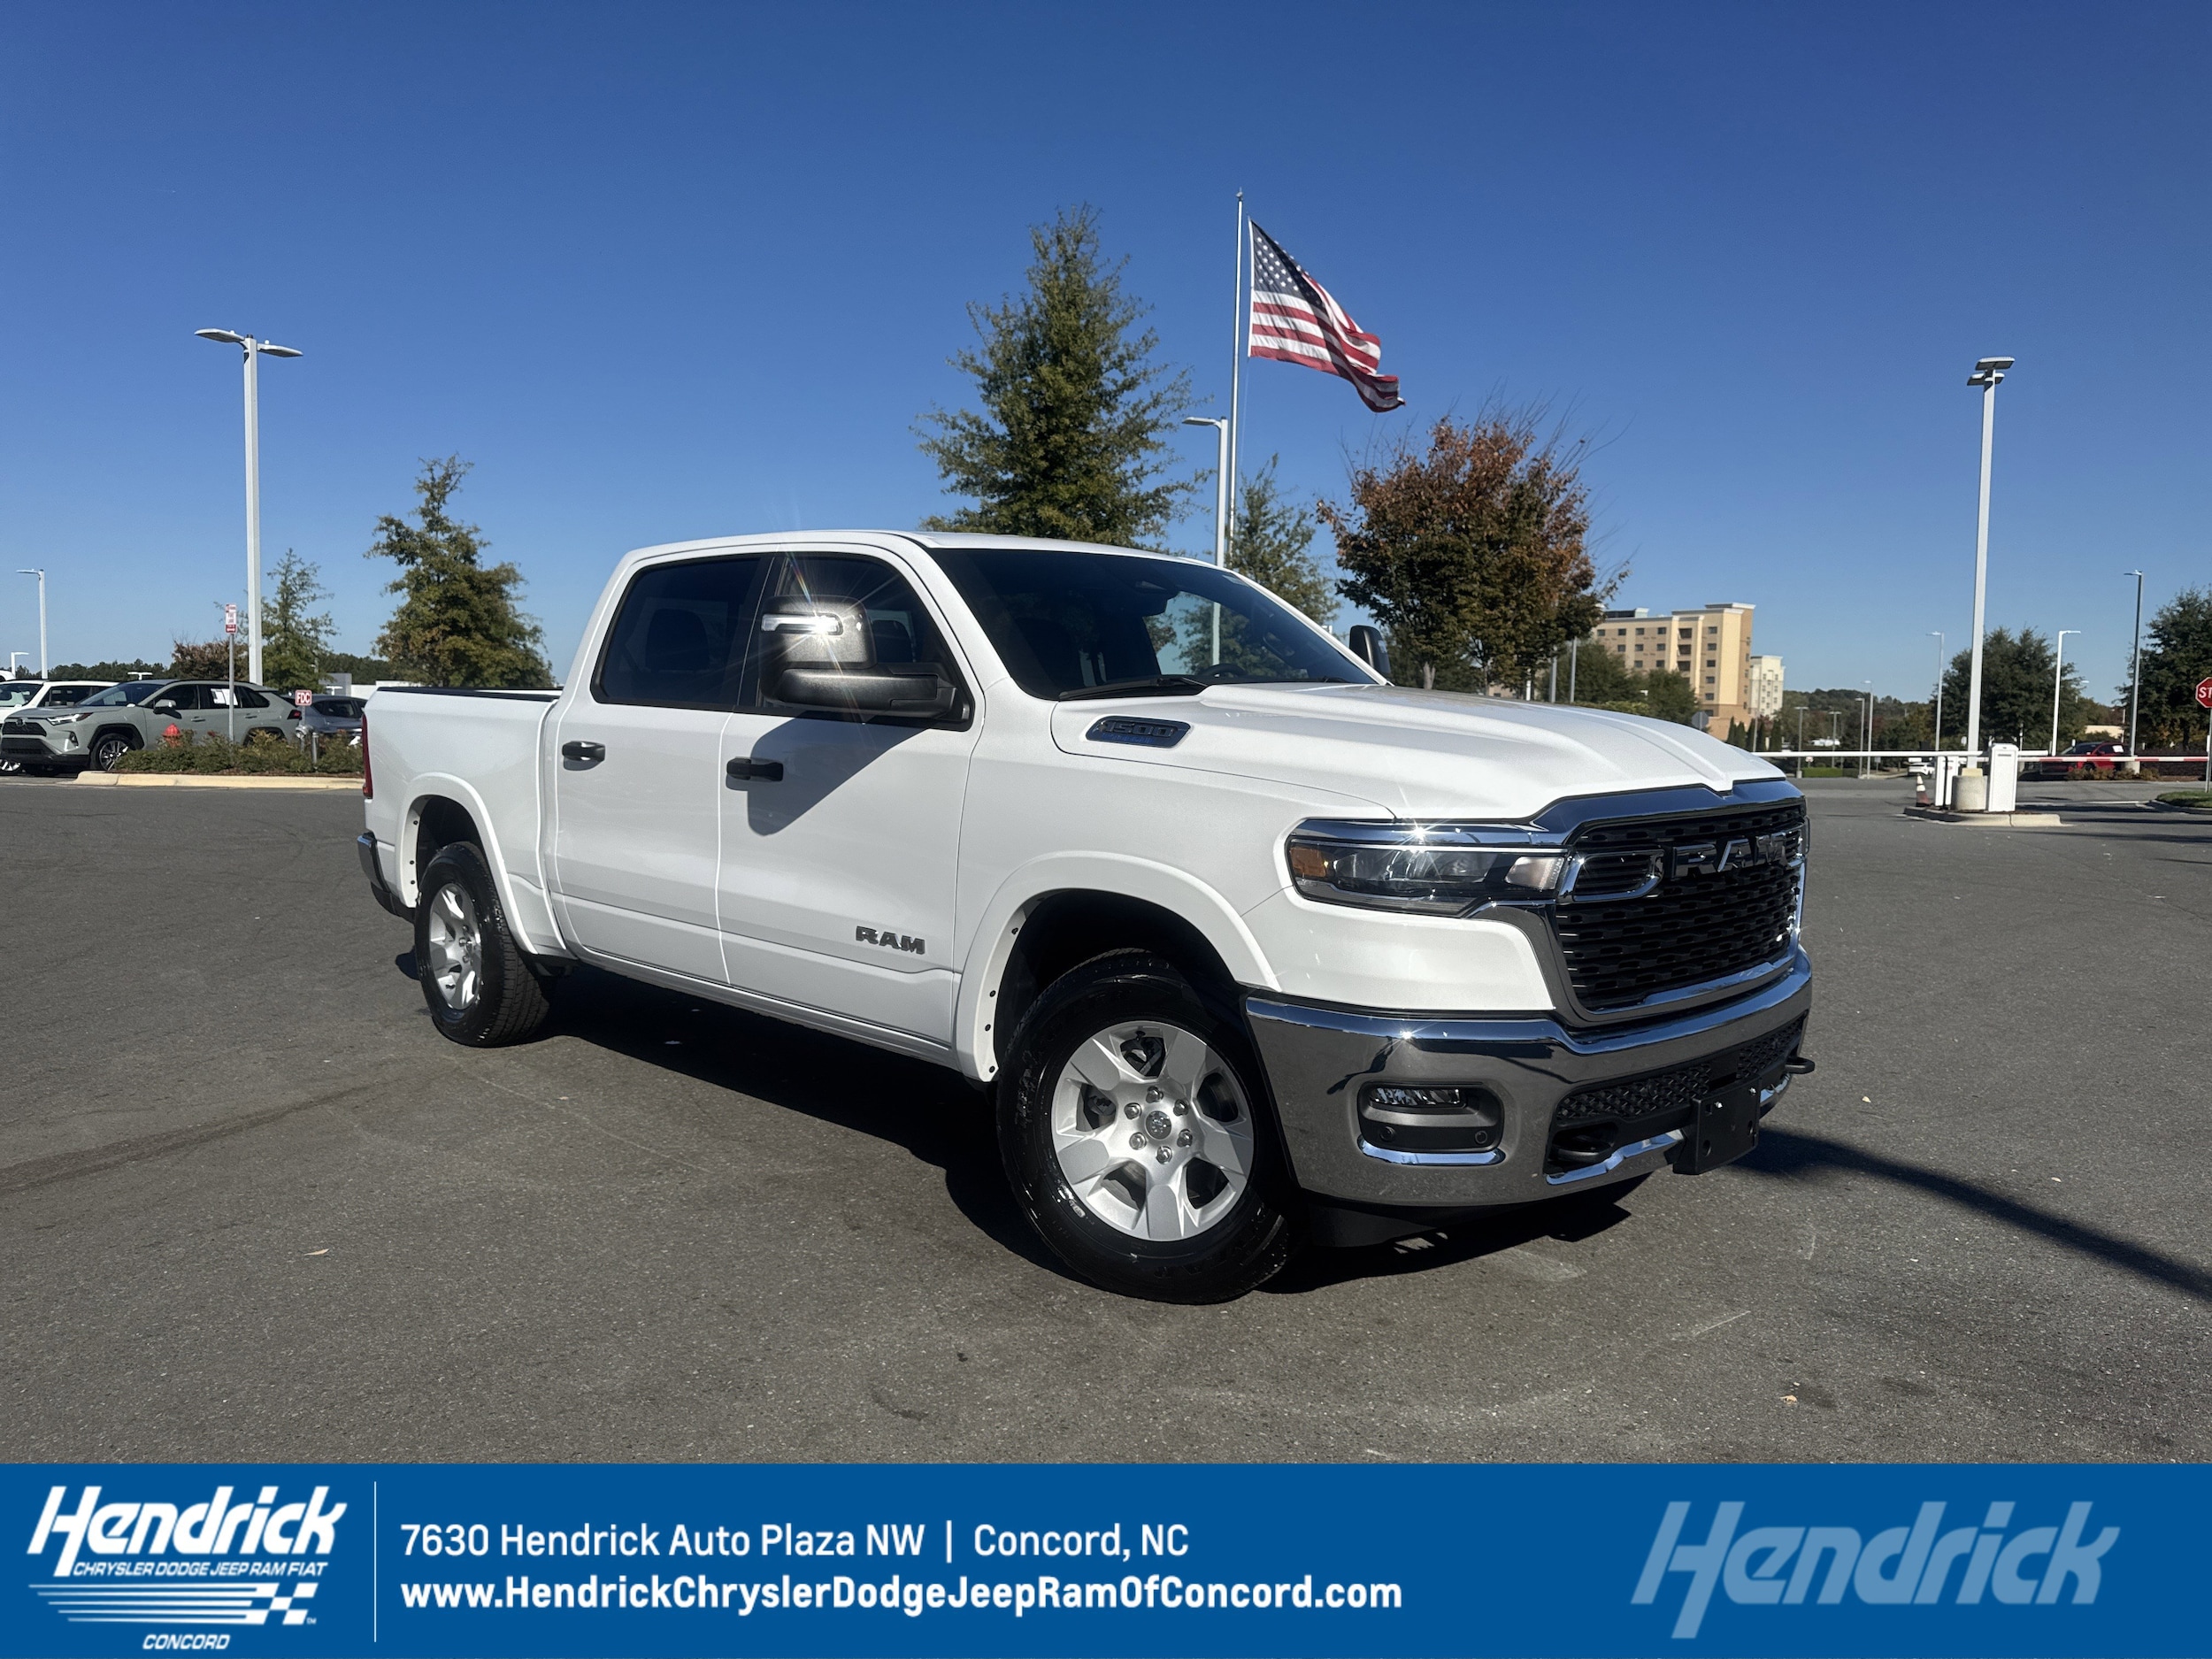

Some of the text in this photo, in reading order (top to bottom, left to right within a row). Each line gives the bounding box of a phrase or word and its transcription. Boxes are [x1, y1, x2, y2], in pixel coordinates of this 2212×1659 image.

[296, 692, 311, 703] FDC
[1101, 719, 1176, 737] 1500
[1671, 833, 1786, 880] RAM
[856, 926, 925, 955] RAM
